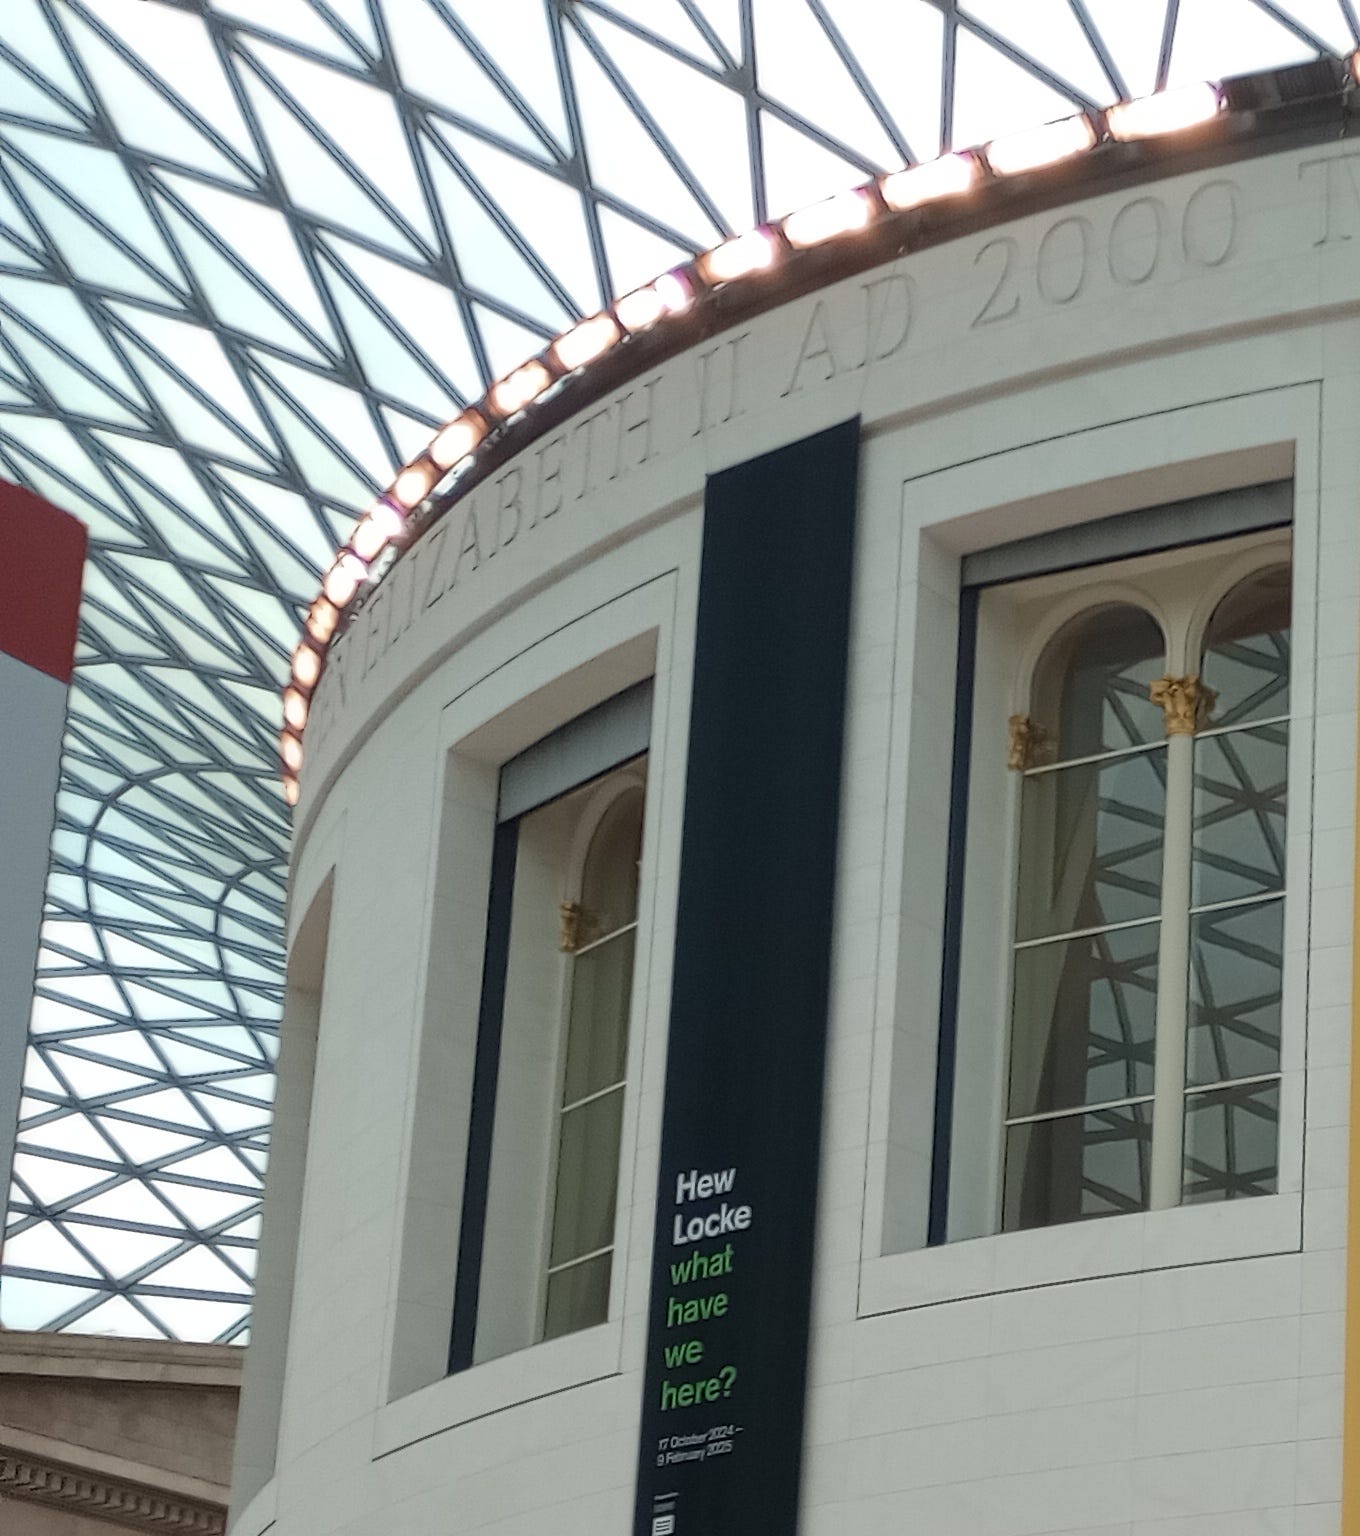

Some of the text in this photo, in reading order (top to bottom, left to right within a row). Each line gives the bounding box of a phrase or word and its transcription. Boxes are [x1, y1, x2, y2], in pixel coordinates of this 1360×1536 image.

[360, 375, 664, 682] ELIZABETH
[692, 332, 750, 438] II
[780, 272, 918, 398] AD
[971, 179, 1241, 329] 2000
[675, 1168, 736, 1204] Hew
[673, 1203, 752, 1245] Locke
[671, 1244, 734, 1286] what
[667, 1293, 728, 1328] have
[664, 1340, 703, 1368] we
[661, 1366, 737, 1410] here?
[670, 1434, 707, 1448] October
[708, 1425, 735, 1440] 2024
[707, 1440, 733, 1456] 2025
